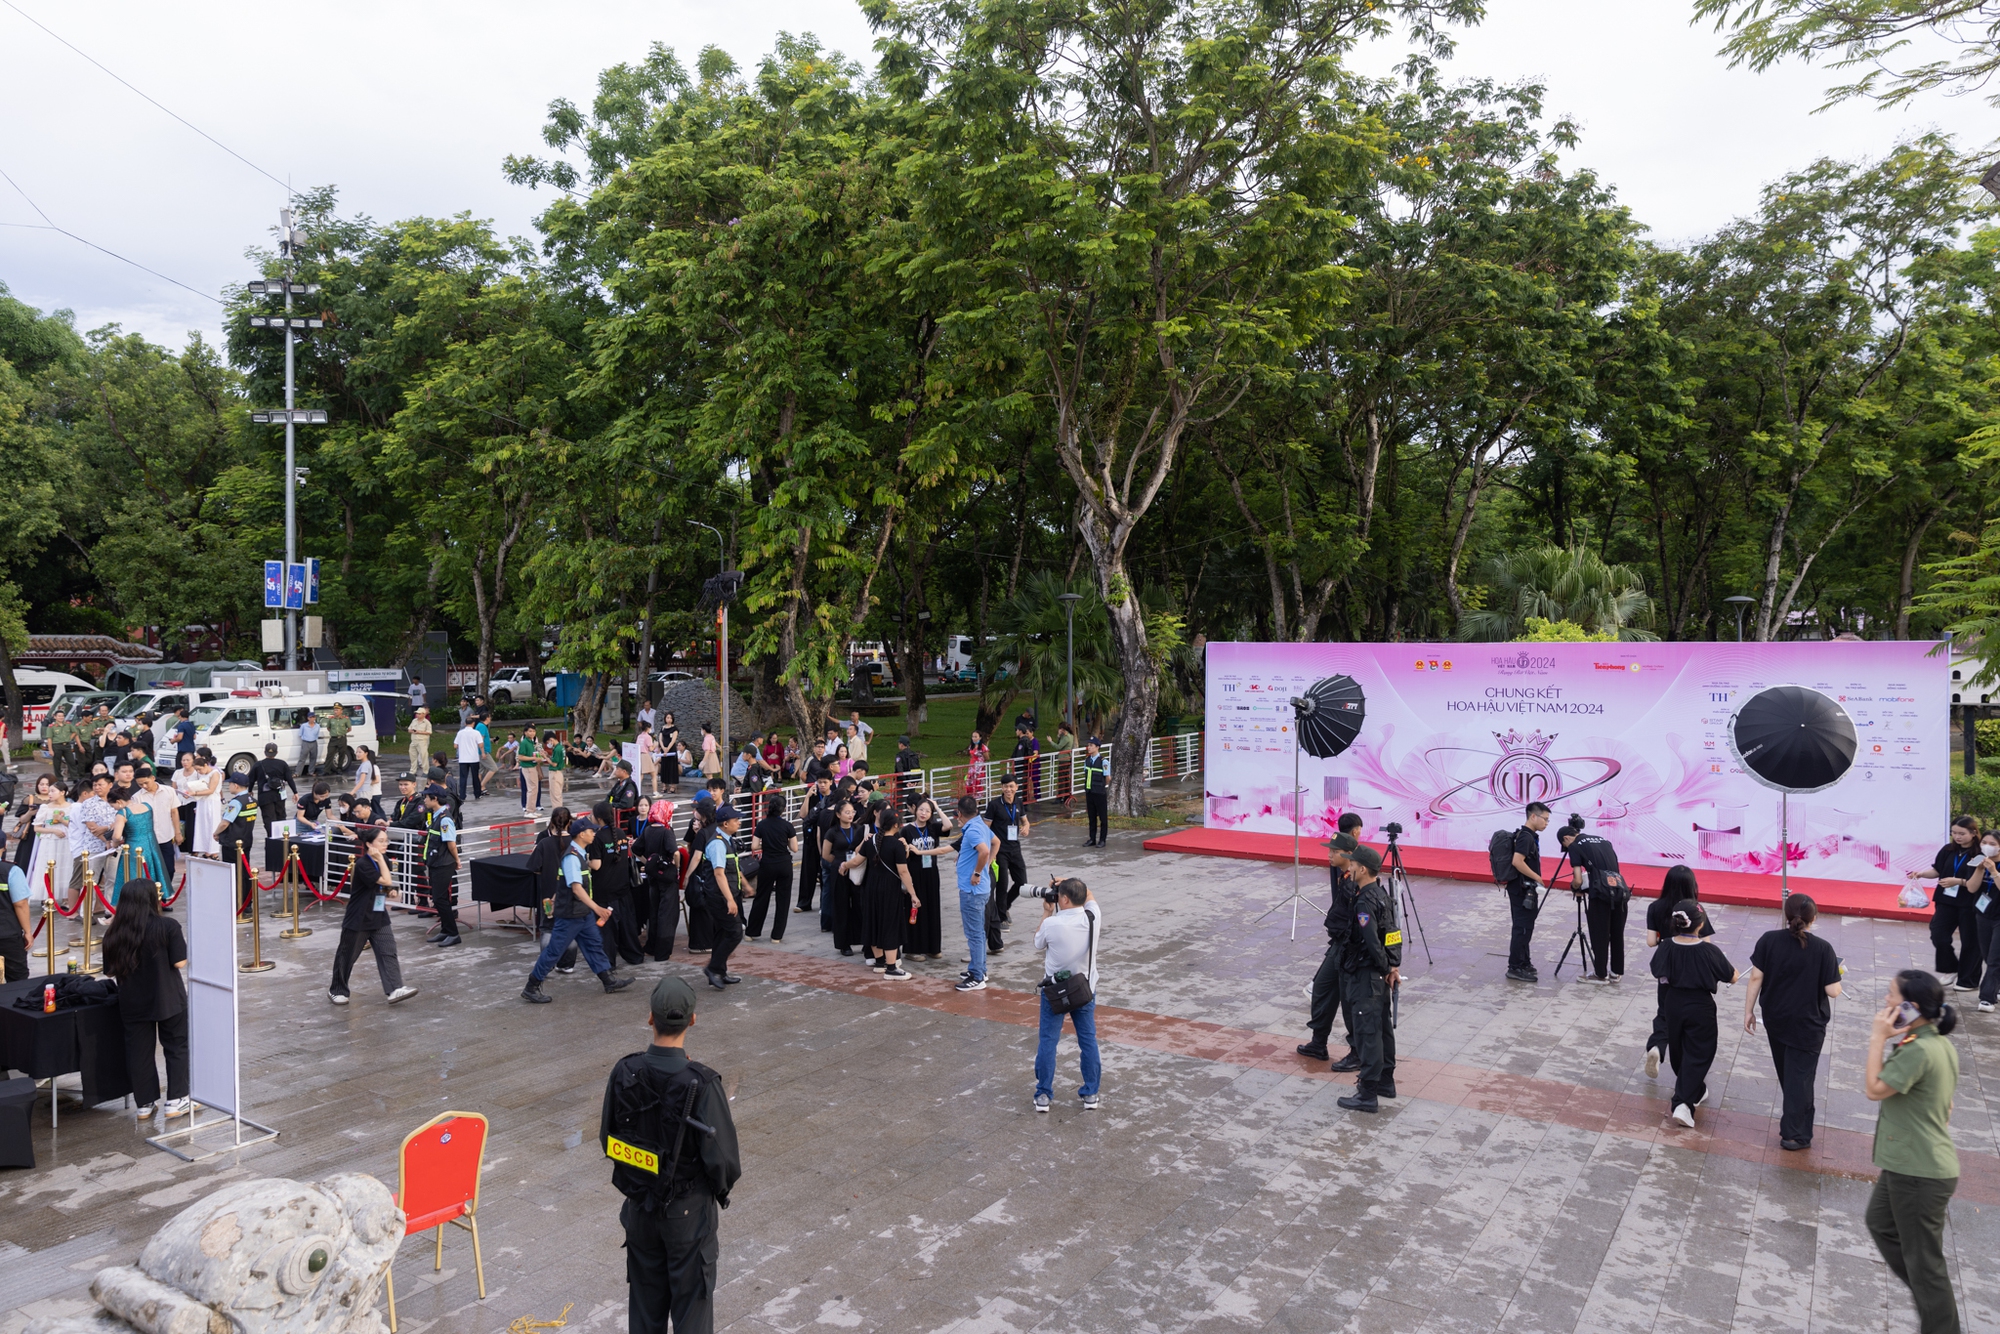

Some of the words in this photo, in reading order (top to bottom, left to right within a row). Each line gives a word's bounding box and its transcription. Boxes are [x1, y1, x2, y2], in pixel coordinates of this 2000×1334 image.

[1530, 656, 1556, 669] 2024
[1223, 684, 1235, 692] TH
[1484, 686, 1535, 699] CHUNG
[1537, 683, 1562, 699] KẾT
[1708, 692, 1728, 702] TH
[1447, 700, 1476, 712] HOA
[1477, 698, 1505, 715] HẬU
[1506, 699, 1535, 715] VIỆT
[1536, 702, 1568, 714] NAM
[1570, 702, 1604, 715] 2024
[612, 1142, 654, 1167] CSCĐ
